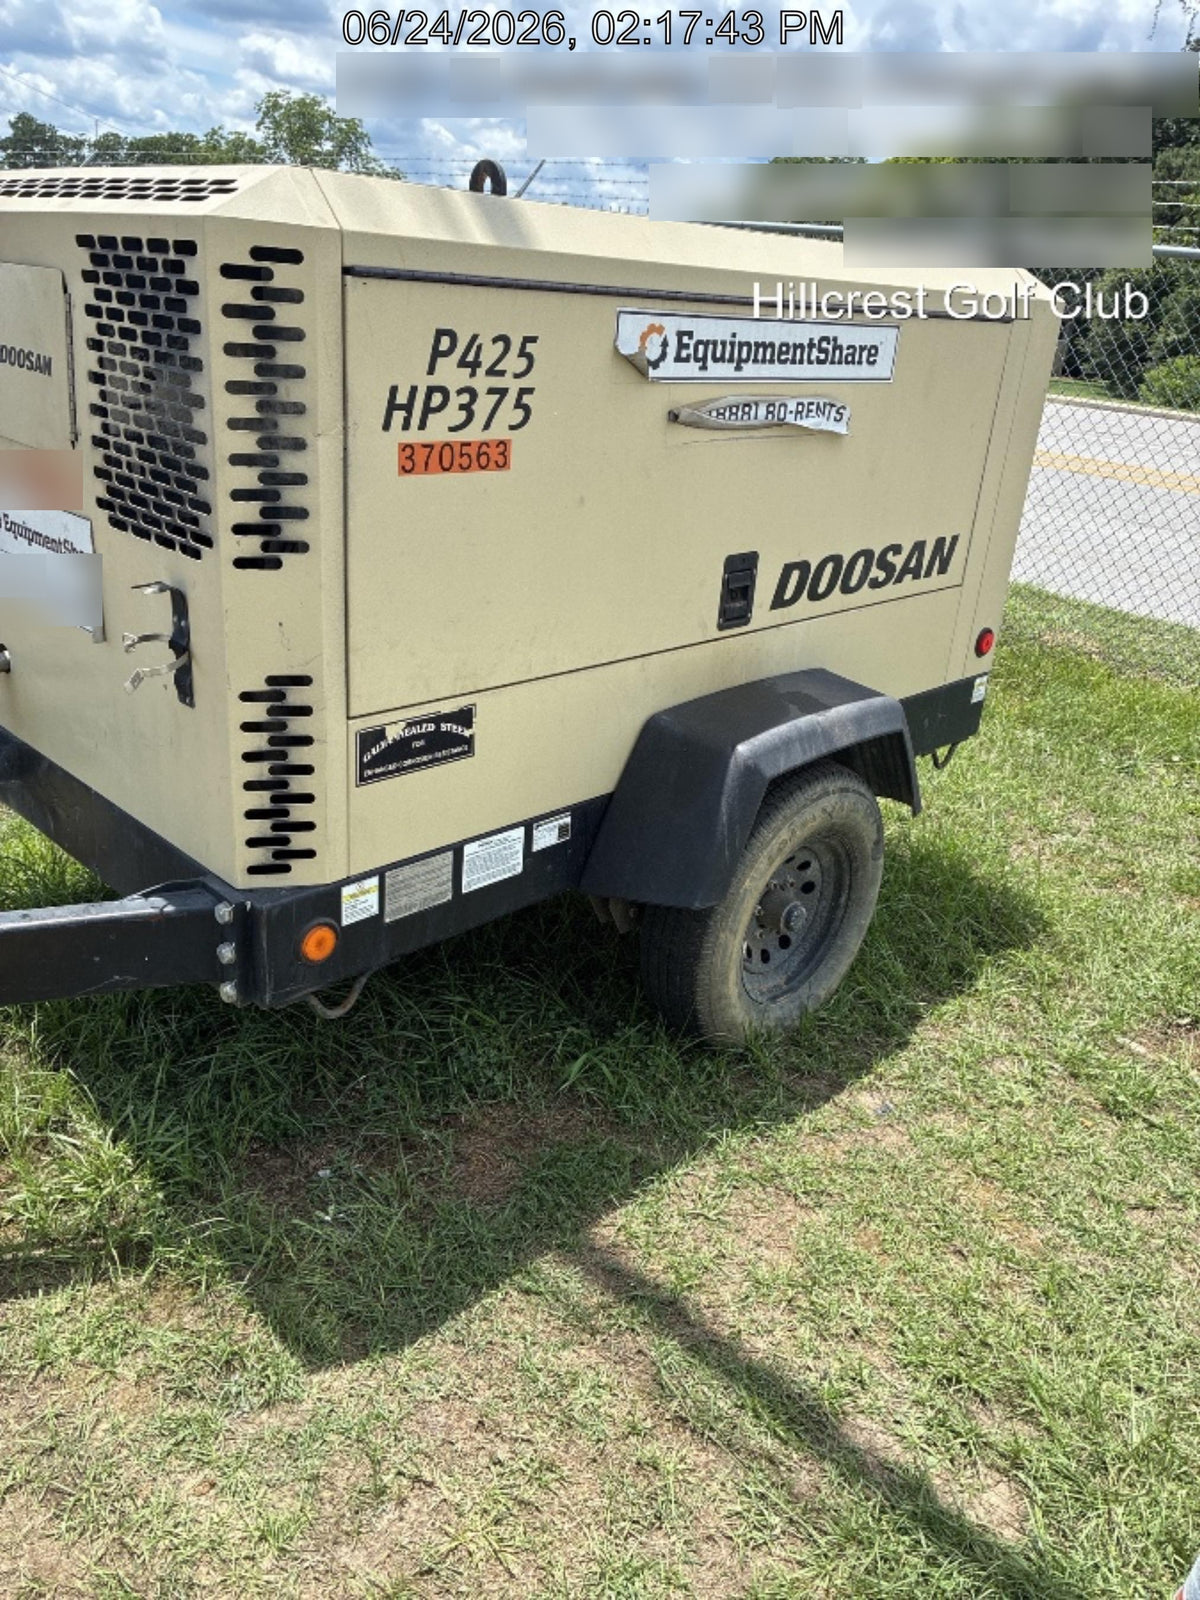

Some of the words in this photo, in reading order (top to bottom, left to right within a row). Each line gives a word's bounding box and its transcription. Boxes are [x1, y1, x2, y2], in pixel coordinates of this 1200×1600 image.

[0, 344, 53, 377] DOOSAN
[426, 328, 539, 380] P425
[673, 330, 880, 372] EquipmentShare
[381, 384, 536, 433] HP375
[400, 440, 508, 474] 370563
[769, 533, 961, 611] DOOSAN
